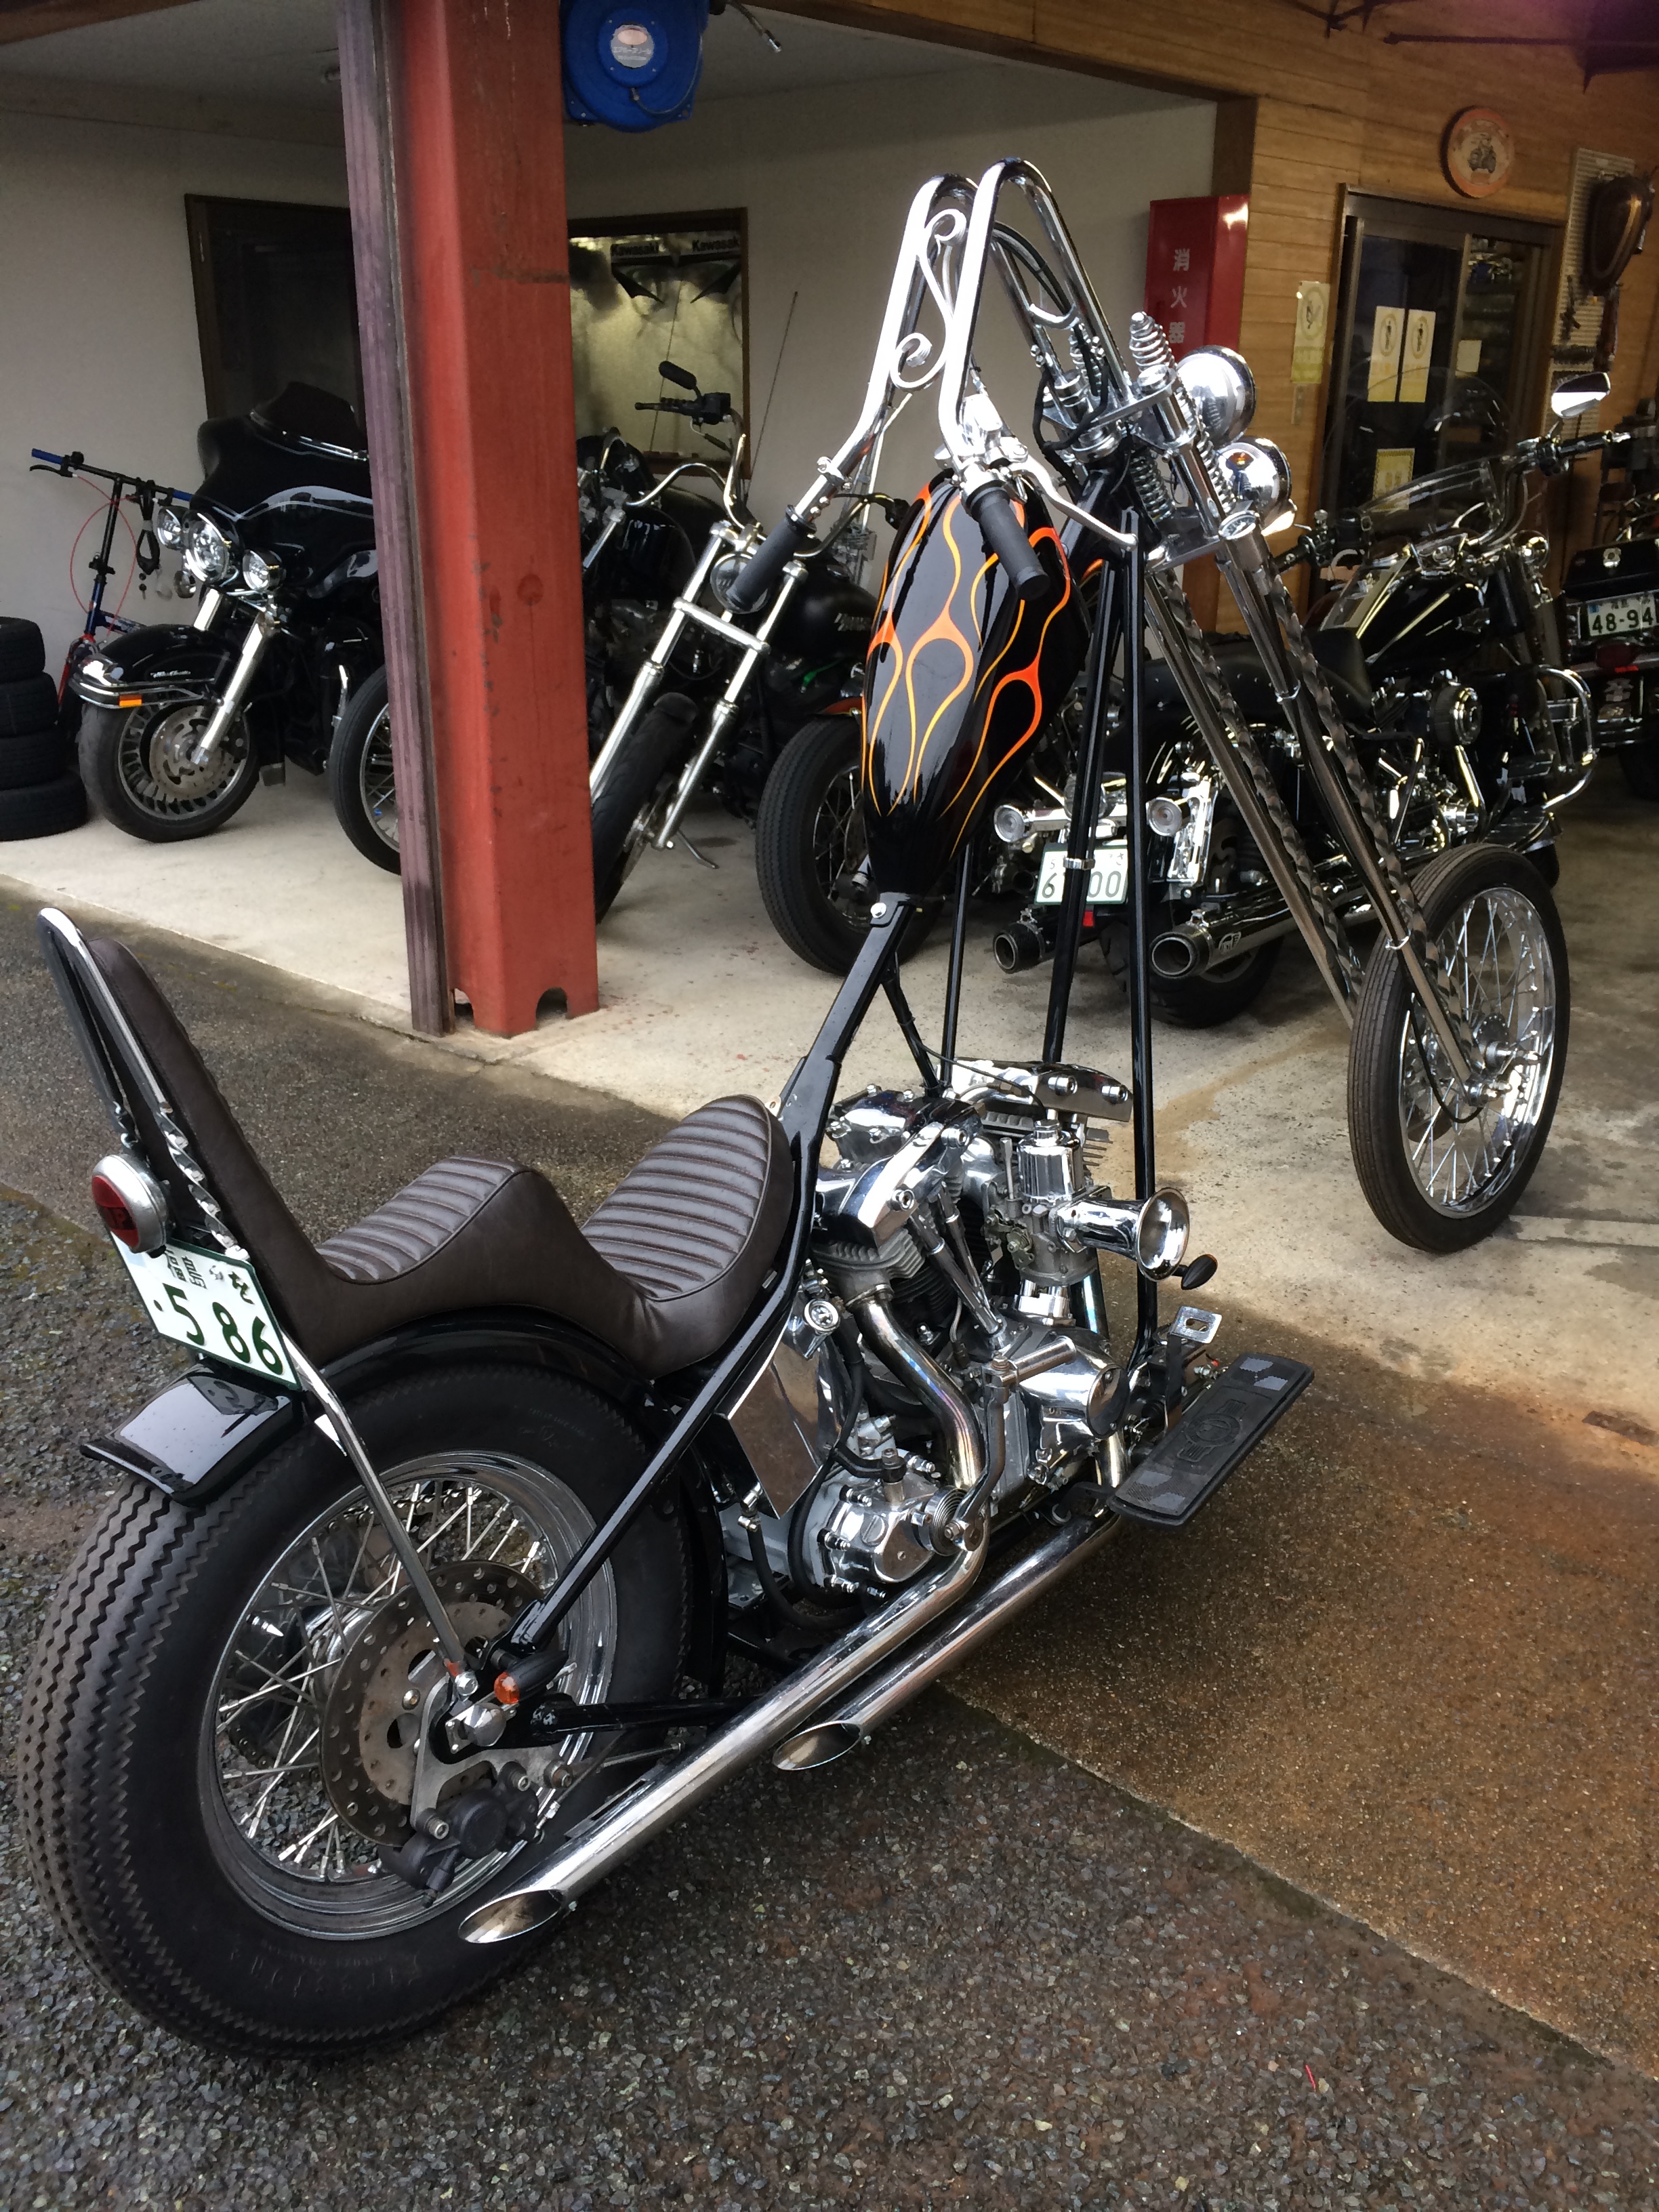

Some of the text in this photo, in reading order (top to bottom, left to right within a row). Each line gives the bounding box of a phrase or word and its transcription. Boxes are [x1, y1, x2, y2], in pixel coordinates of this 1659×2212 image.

[692, 236, 740, 252] Kawasak
[1168, 248, 1190, 344] 消火器
[1592, 607, 1654, 634] 48-94
[165, 1249, 207, 1290] 福島
